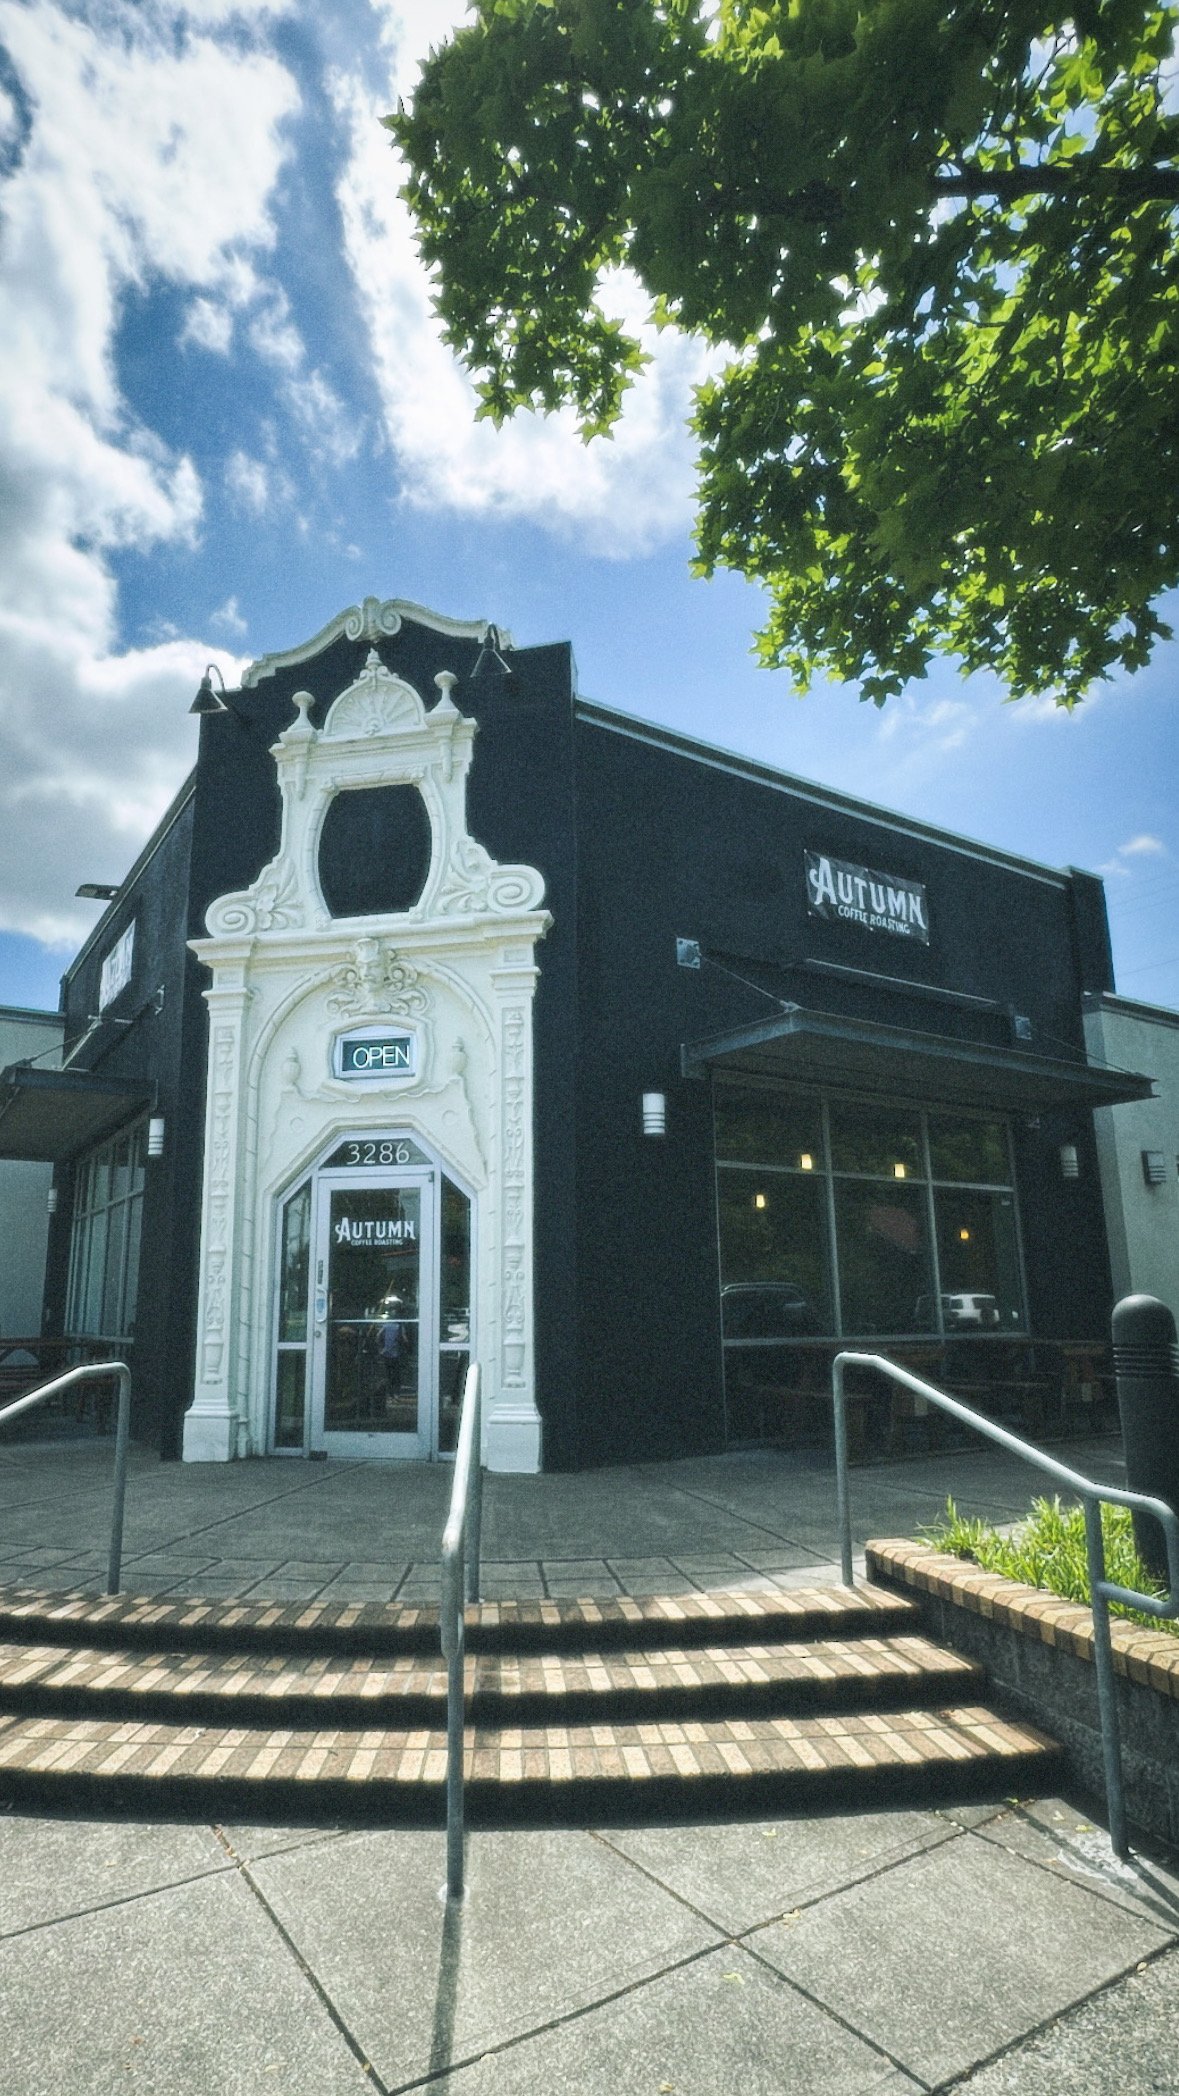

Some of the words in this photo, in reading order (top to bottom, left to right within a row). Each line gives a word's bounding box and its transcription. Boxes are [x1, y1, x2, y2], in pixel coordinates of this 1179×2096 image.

[809, 857, 927, 929] AUTUMN
[838, 905, 867, 924] COFFEE
[870, 914, 911, 934] ROASTING
[353, 1045, 410, 1069] OPEN
[347, 1142, 409, 1165] 3286
[335, 1217, 416, 1243] AUTUMN
